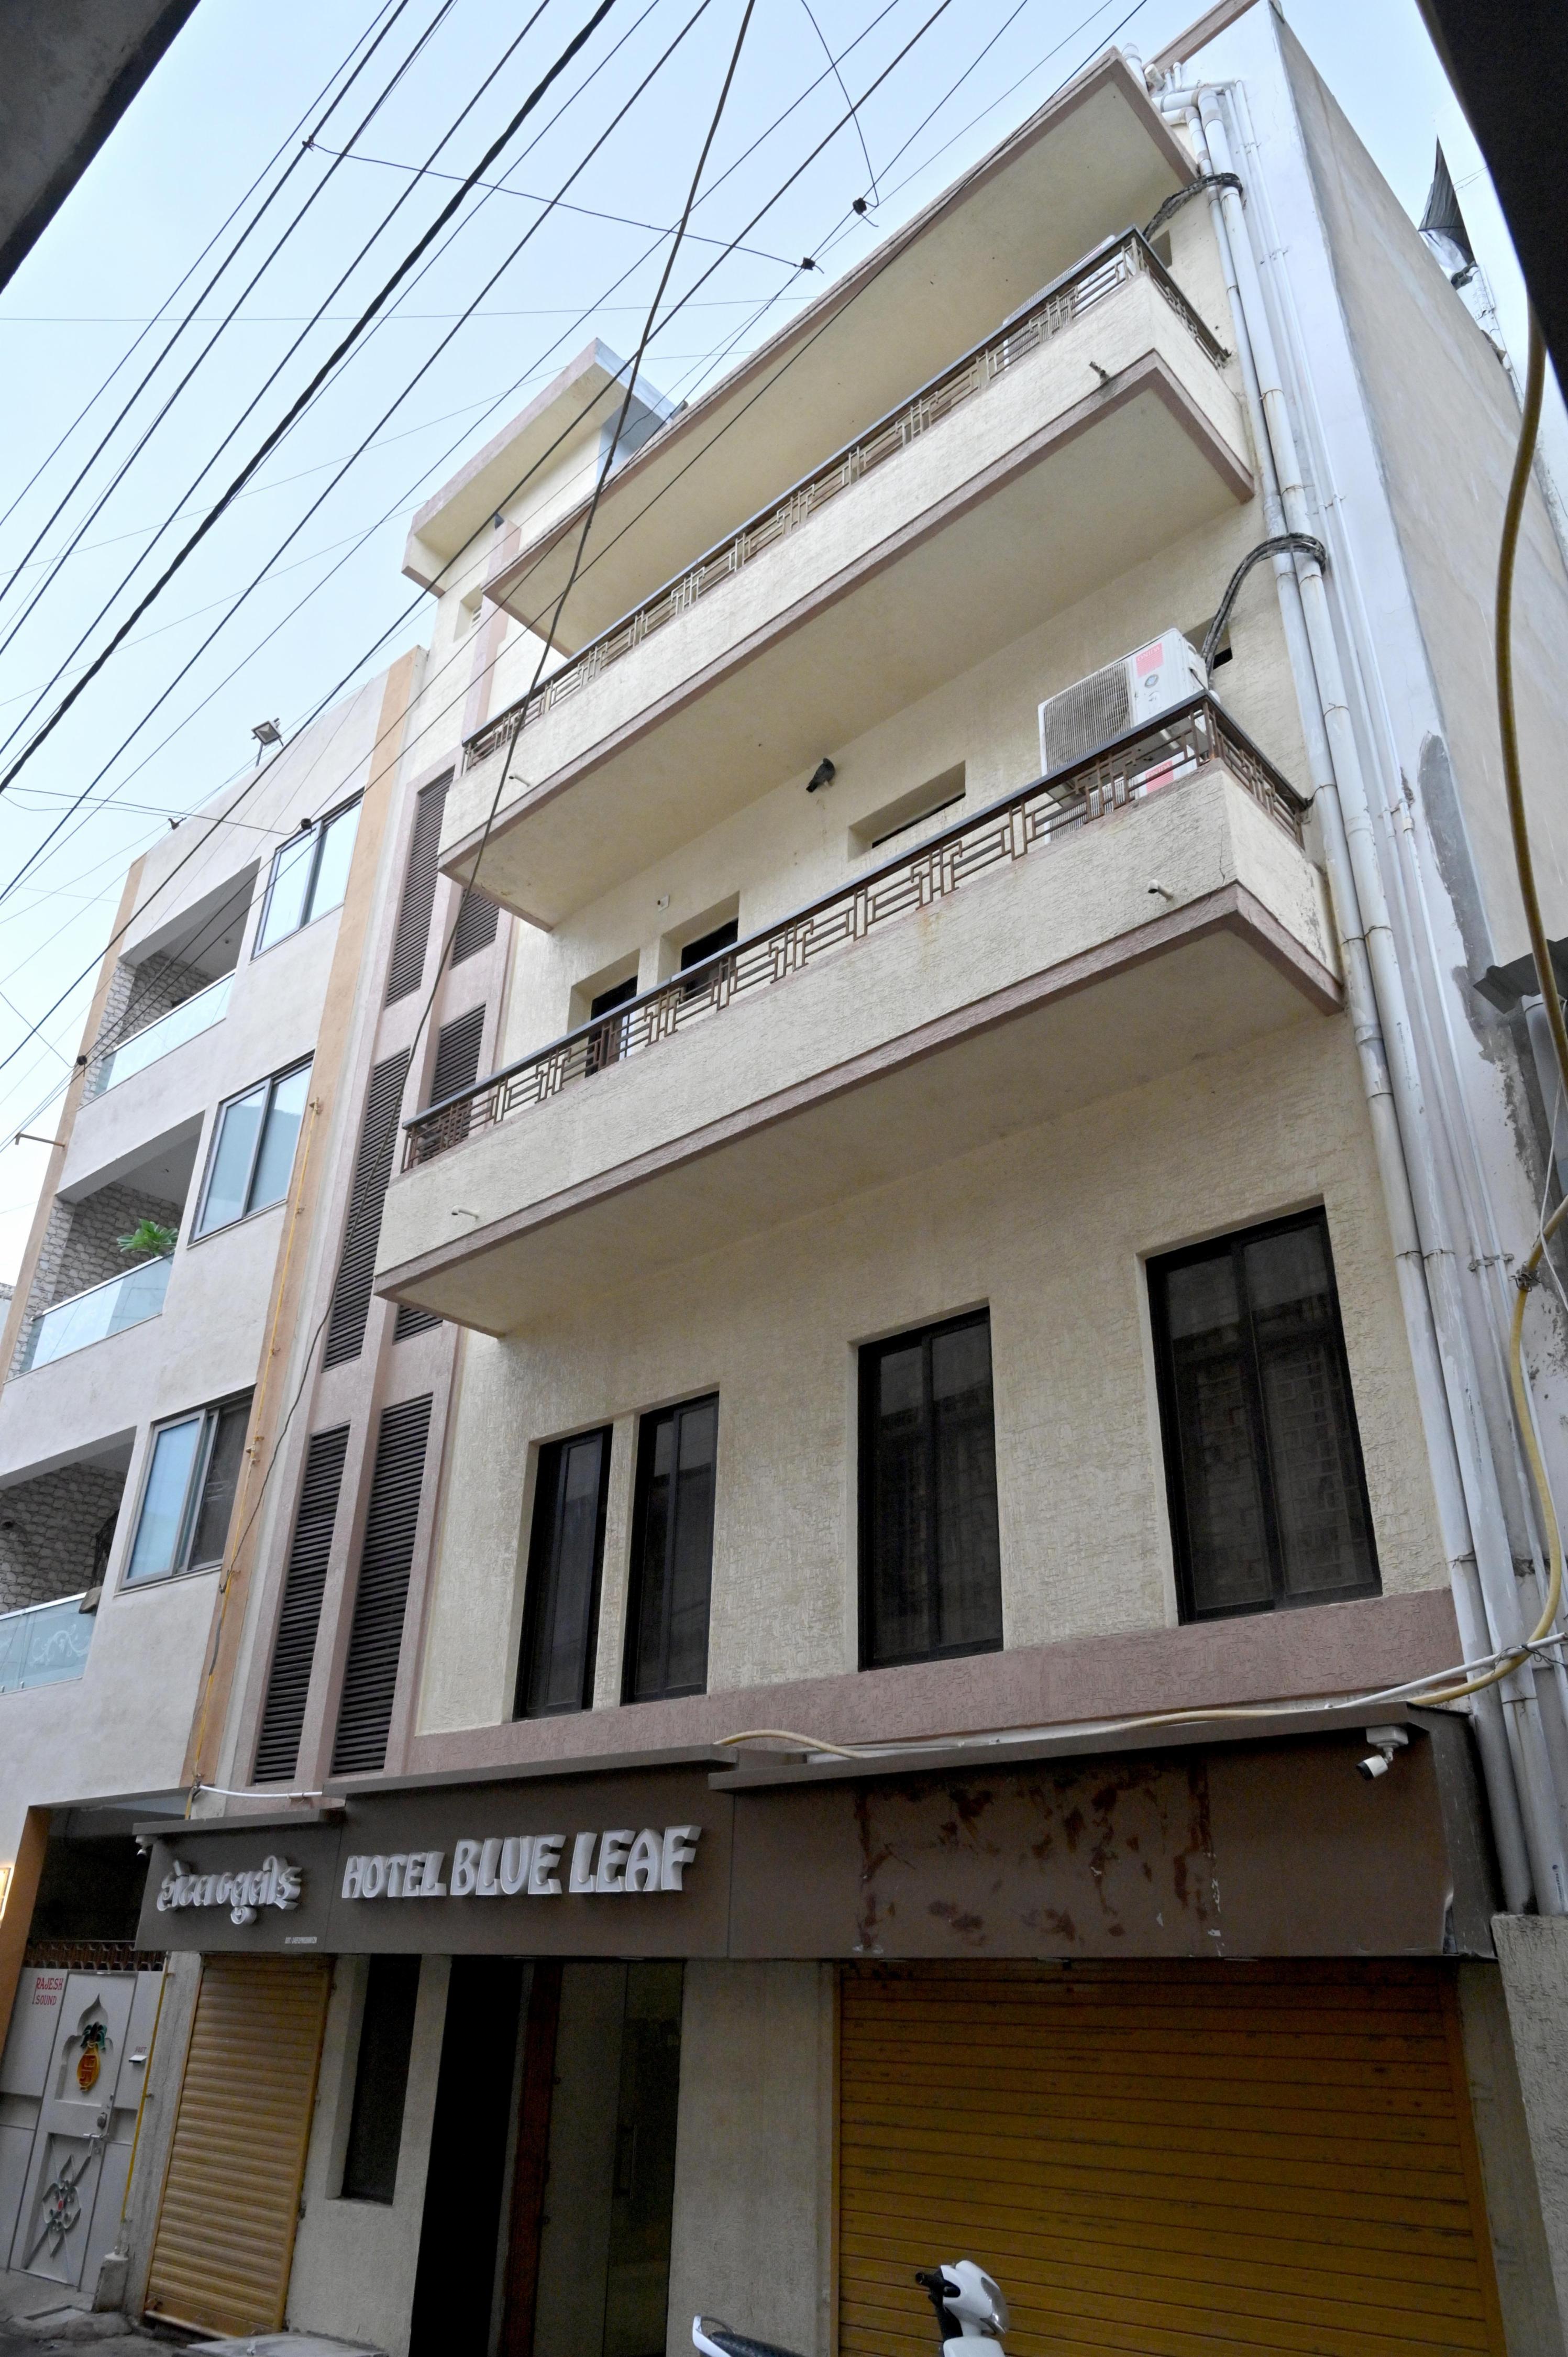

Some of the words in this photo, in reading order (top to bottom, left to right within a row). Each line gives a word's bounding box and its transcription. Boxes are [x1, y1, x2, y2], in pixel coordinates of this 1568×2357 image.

[341, 1851, 447, 1899] HOTEL
[449, 1833, 566, 1896] BLUE
[568, 1824, 702, 1893] LEAF
[35, 1977, 63, 1990] RAJESH
[35, 1995, 57, 2006] SOUND
